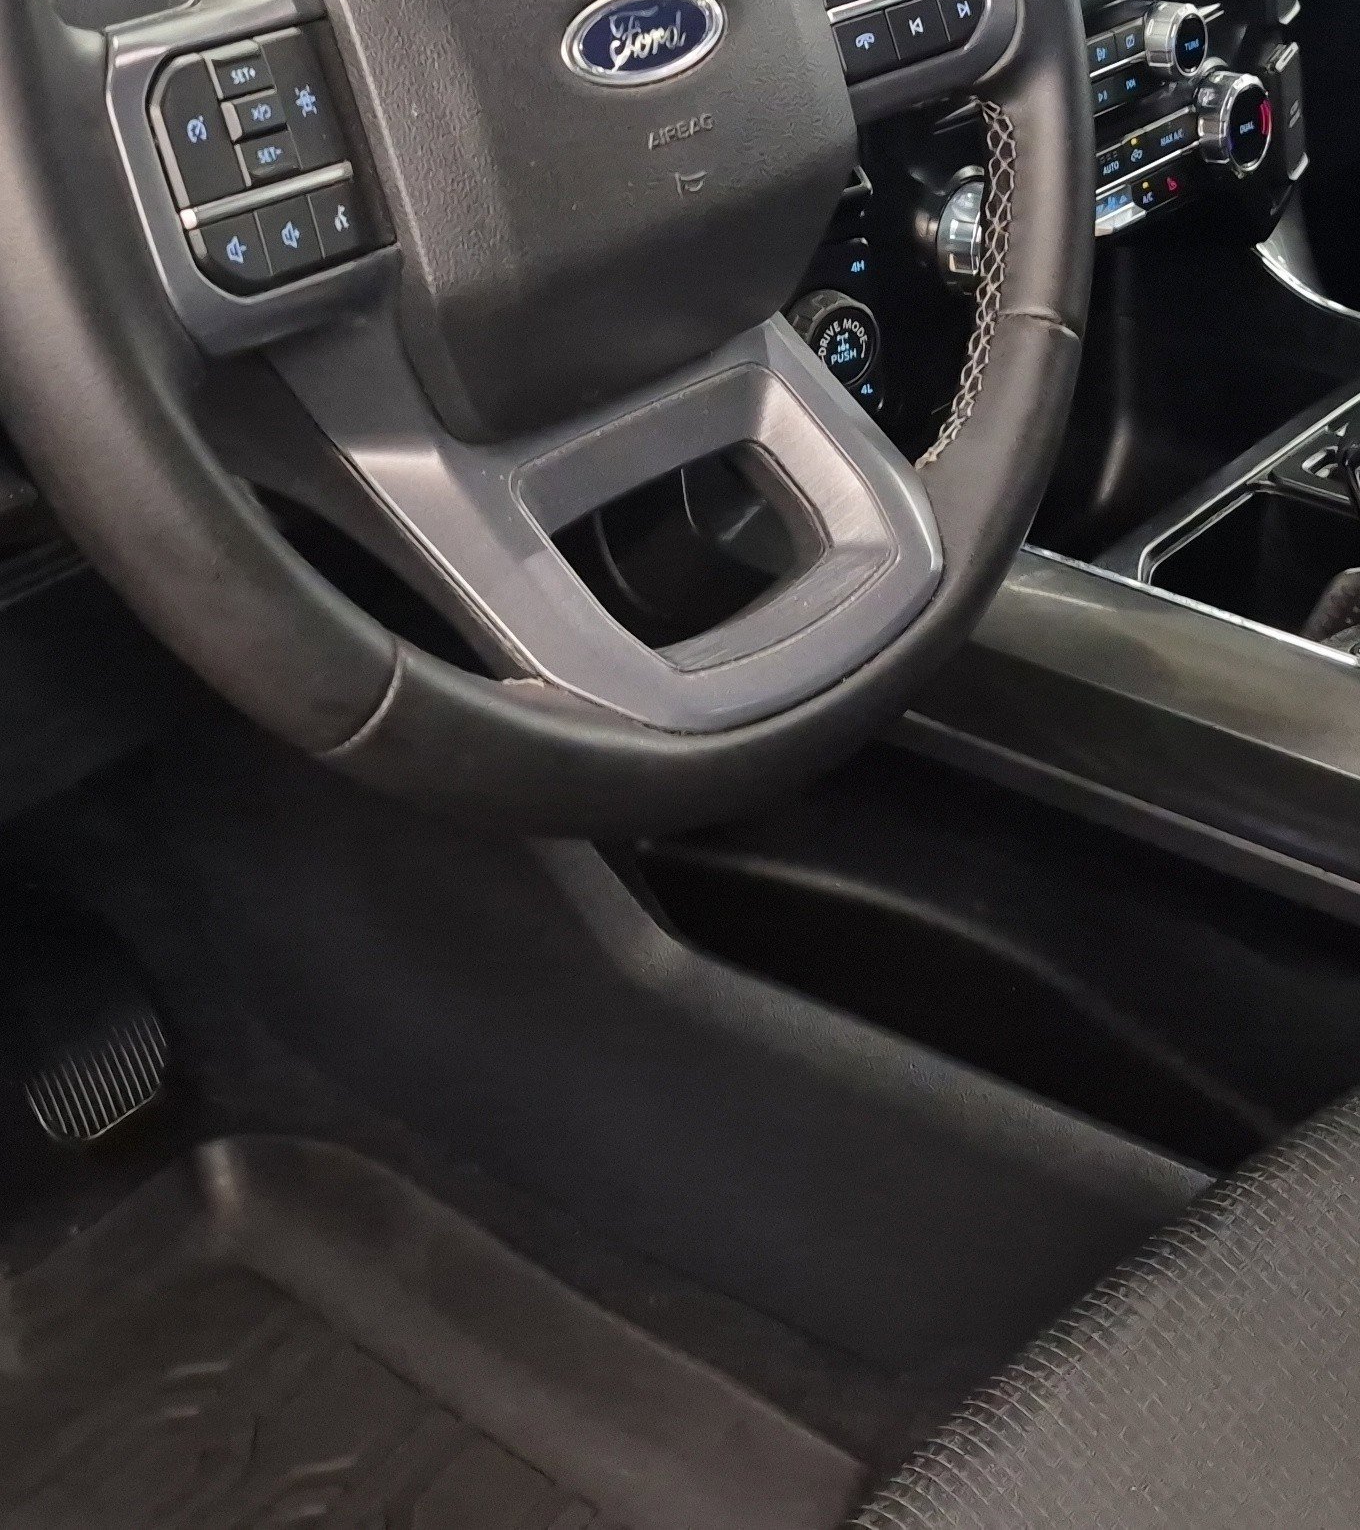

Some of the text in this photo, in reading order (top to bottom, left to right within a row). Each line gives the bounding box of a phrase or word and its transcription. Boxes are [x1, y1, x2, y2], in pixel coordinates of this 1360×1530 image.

[608, 3, 687, 73] Ford
[647, 111, 714, 152] AIRBAG
[1102, 160, 1120, 176] AUTO
[850, 259, 865, 273] 4H
[818, 317, 868, 357] DRIVE MODE
[830, 347, 857, 366] PUSH
[860, 383, 874, 395] 4L
